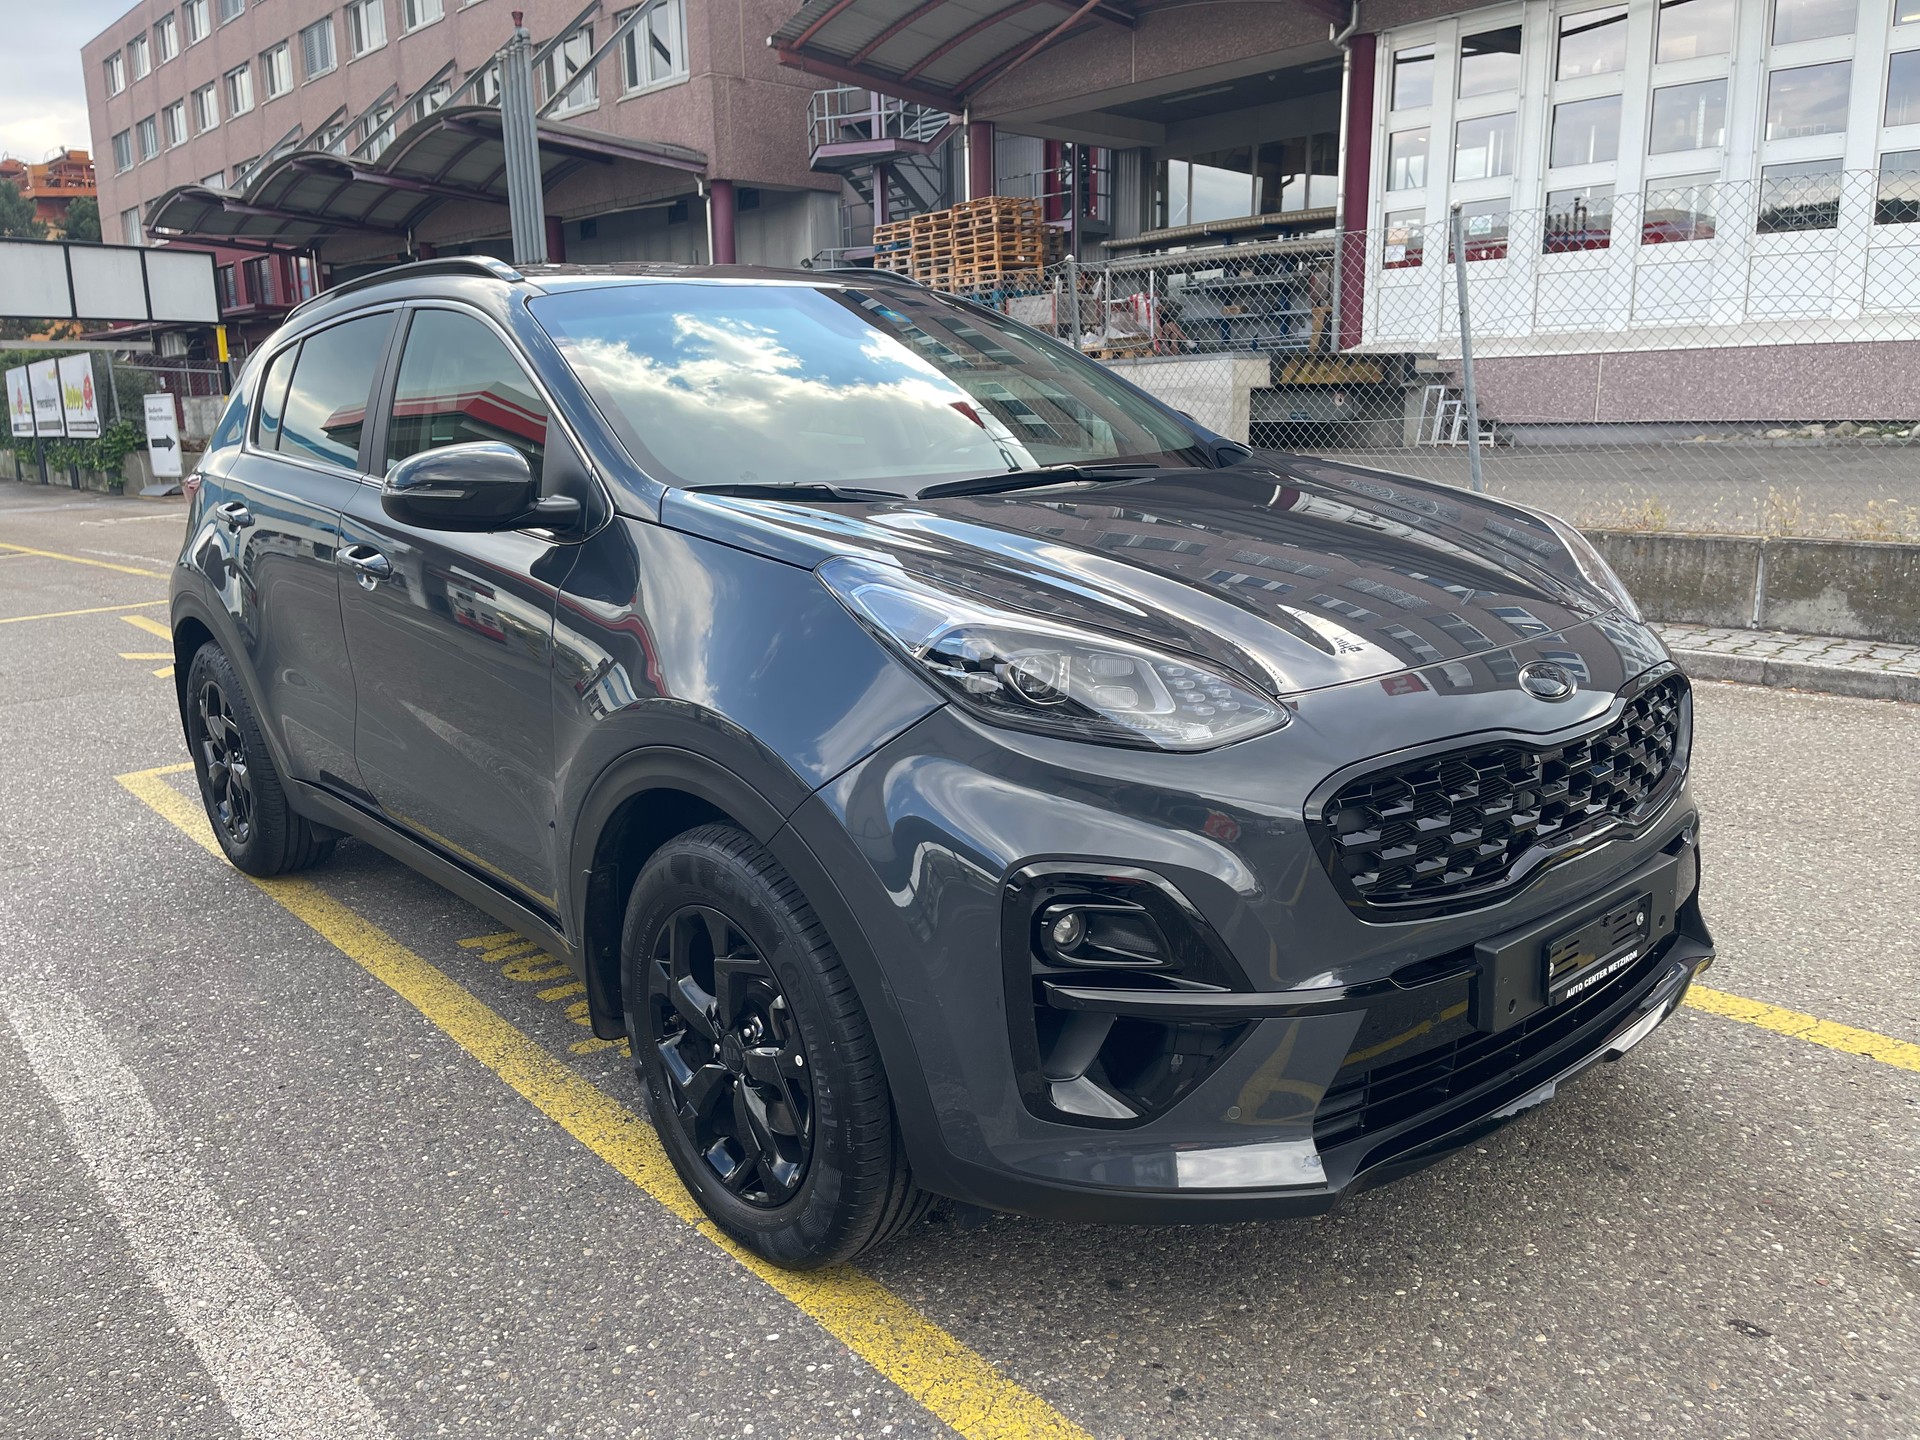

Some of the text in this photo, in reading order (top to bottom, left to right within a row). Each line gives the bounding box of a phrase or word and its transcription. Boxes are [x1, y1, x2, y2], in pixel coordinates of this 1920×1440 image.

[1566, 950, 1638, 999] AUTO CENTER WETZIKON
